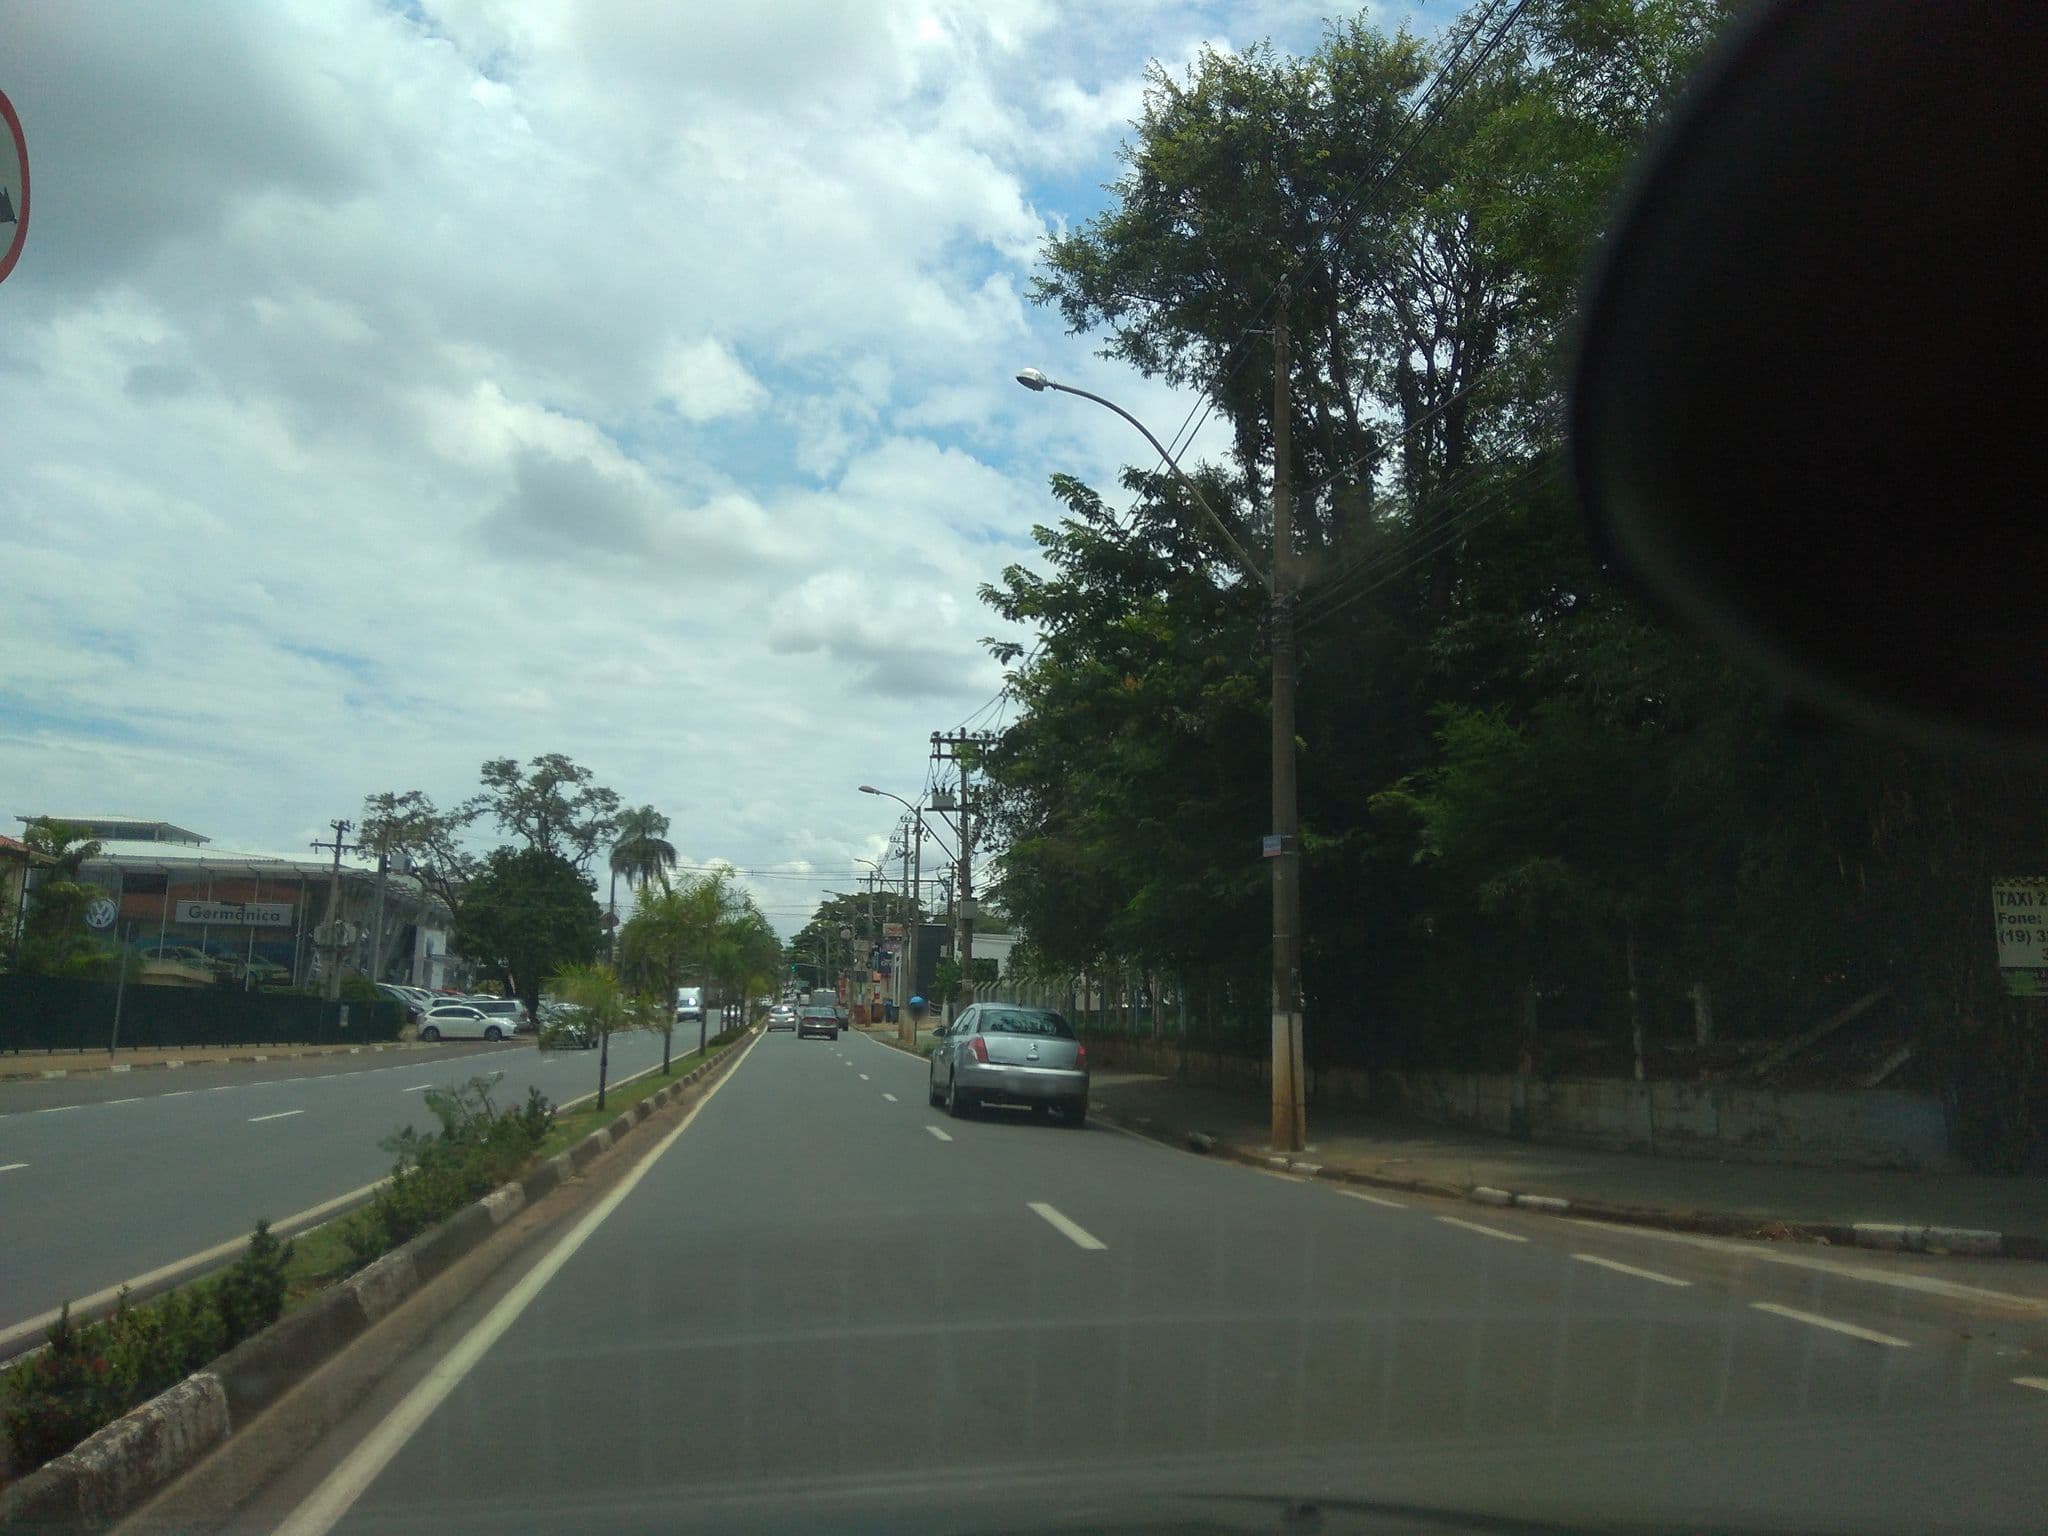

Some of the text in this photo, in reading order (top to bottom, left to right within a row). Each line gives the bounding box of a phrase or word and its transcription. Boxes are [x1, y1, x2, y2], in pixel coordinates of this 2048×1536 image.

[1998, 891, 2034, 907] TAXI
[1999, 911, 2042, 925] Fone:
[1999, 929, 2048, 945] (19) 3
